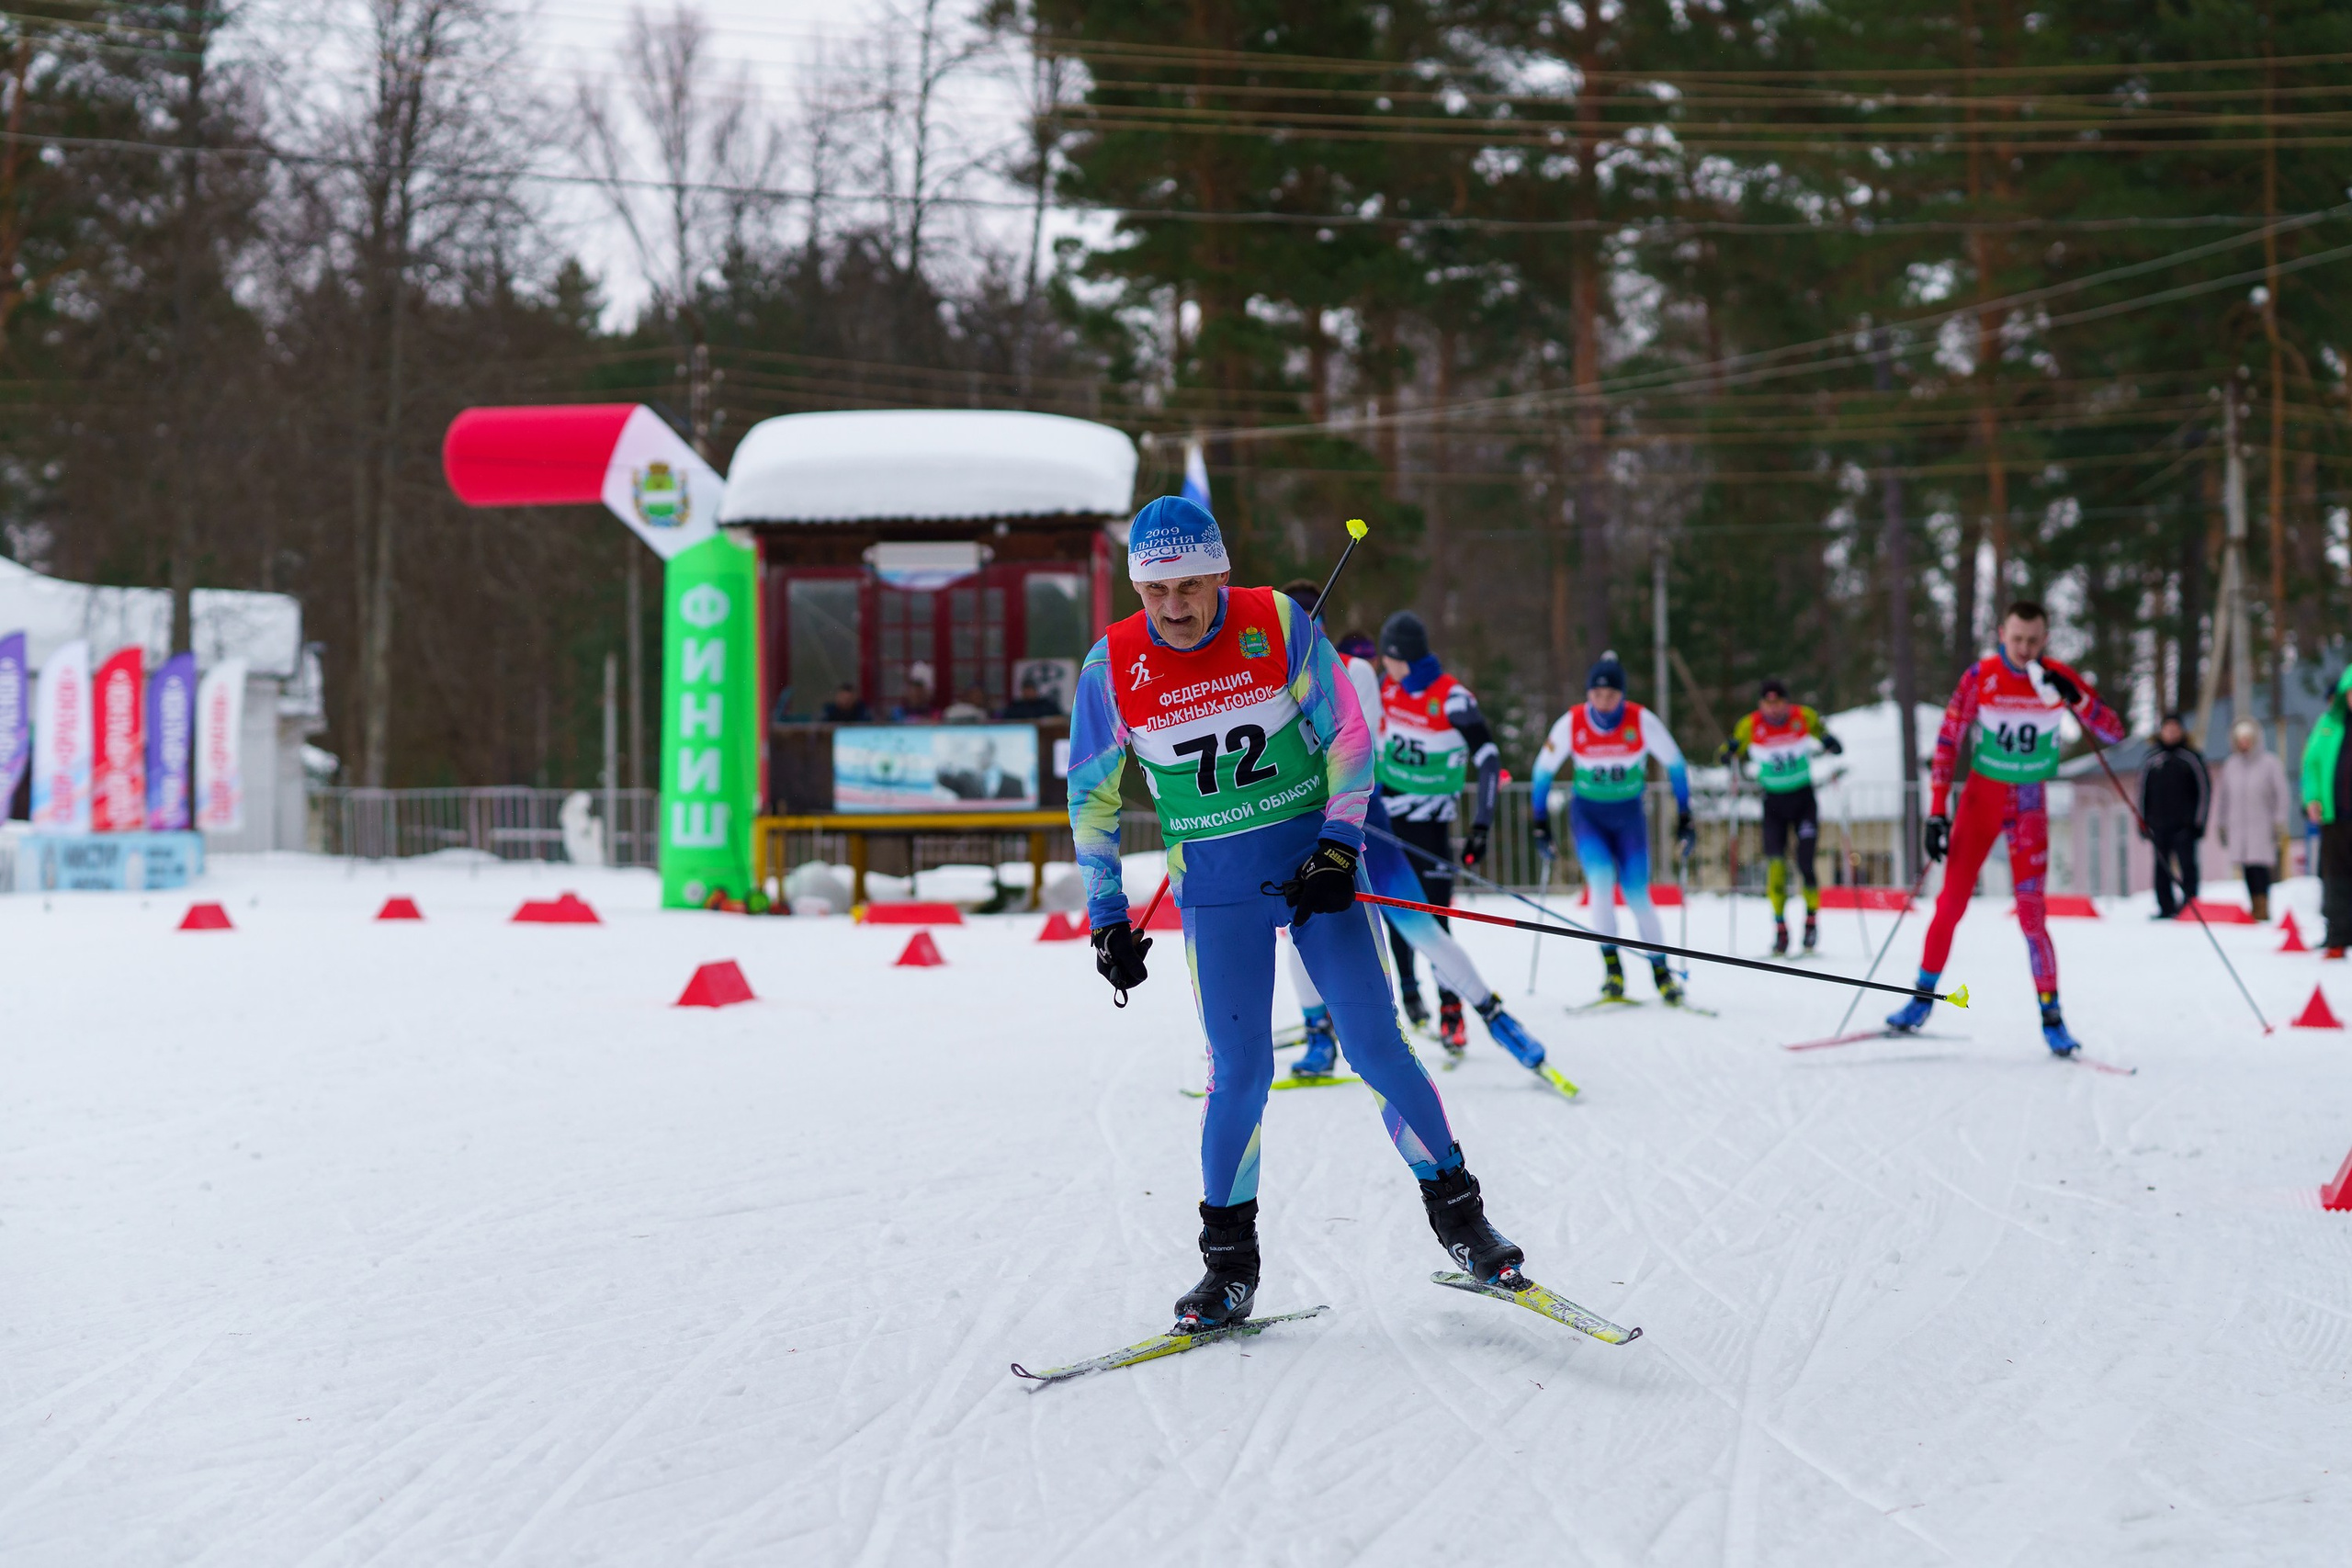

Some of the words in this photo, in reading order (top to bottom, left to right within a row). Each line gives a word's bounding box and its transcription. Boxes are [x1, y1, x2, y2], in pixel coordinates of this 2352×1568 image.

[1135, 535, 1195, 552] ЛЫЖНЯ
[1145, 526, 1181, 539] 2009
[1134, 544, 1197, 561] РОССИИ
[1159, 670, 1254, 707] ФЕДЕРАЦИЯ
[671, 581, 732, 849] ФИНИШ
[1146, 698, 1223, 733] ЛЫЖНЫХ
[1223, 684, 1276, 711] ГОНОК
[1391, 733, 1427, 767] 25
[1996, 722, 2038, 753] 49
[1172, 723, 1279, 797] 72
[1258, 774, 1321, 812] ОБЛАСТИ
